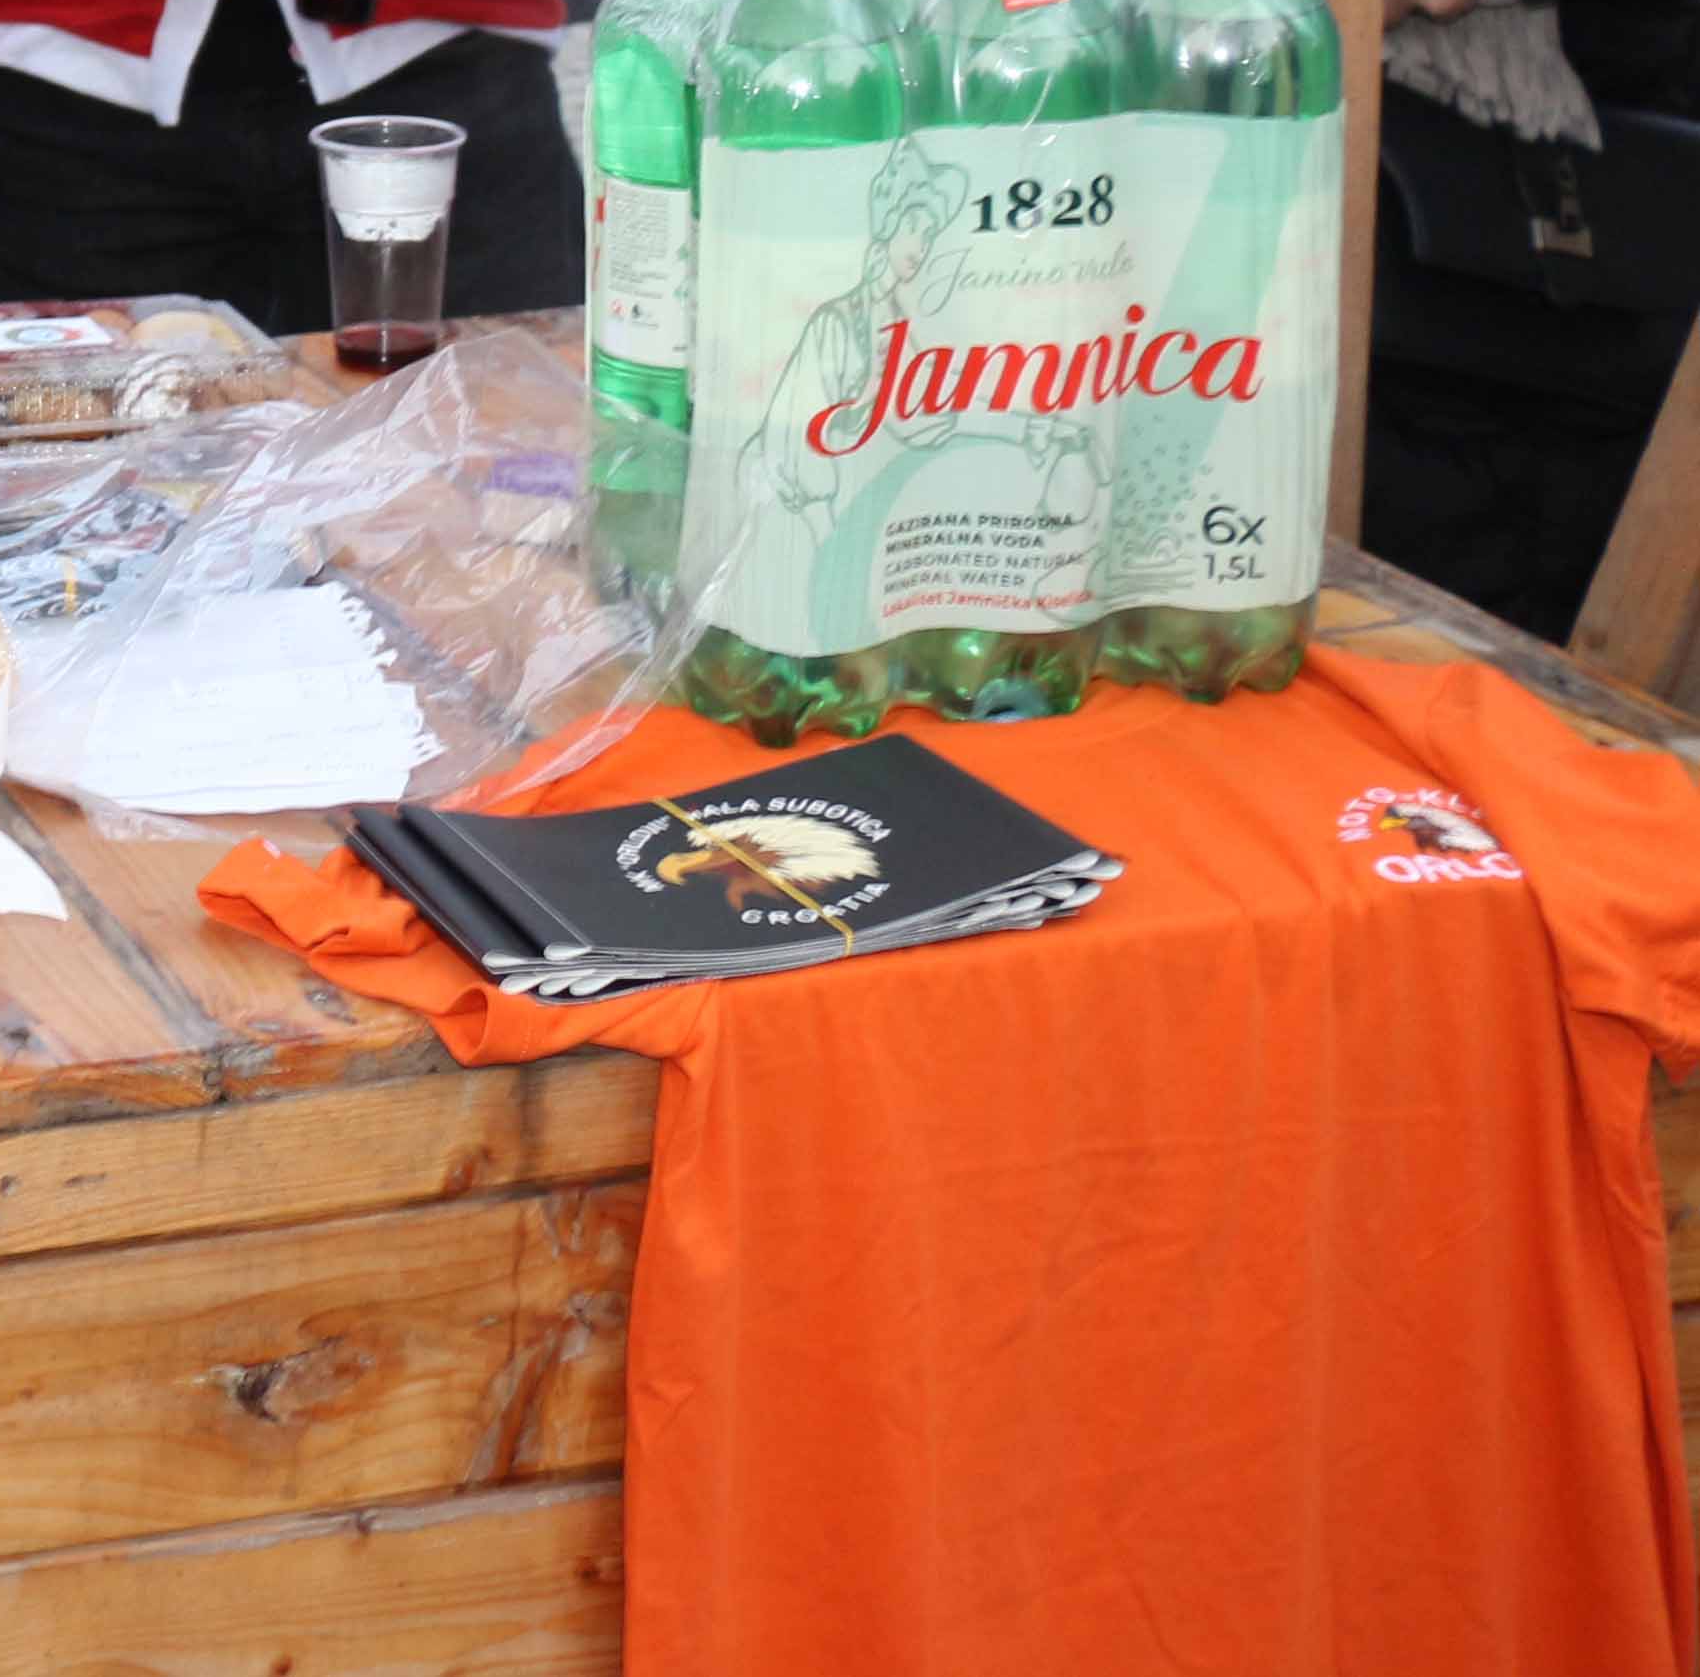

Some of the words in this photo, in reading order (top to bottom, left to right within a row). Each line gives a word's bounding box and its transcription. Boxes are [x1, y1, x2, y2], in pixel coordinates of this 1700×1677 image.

[970, 173, 1115, 234] 1828
[805, 304, 1266, 458] Jamnica
[990, 534, 1046, 549] VODA
[1202, 504, 1268, 547] 6x
[960, 574, 1026, 588] WATER
[1203, 553, 1269, 585] 1,5L
[766, 796, 893, 844] SUBOTICA
[740, 881, 892, 926] CROATIA
